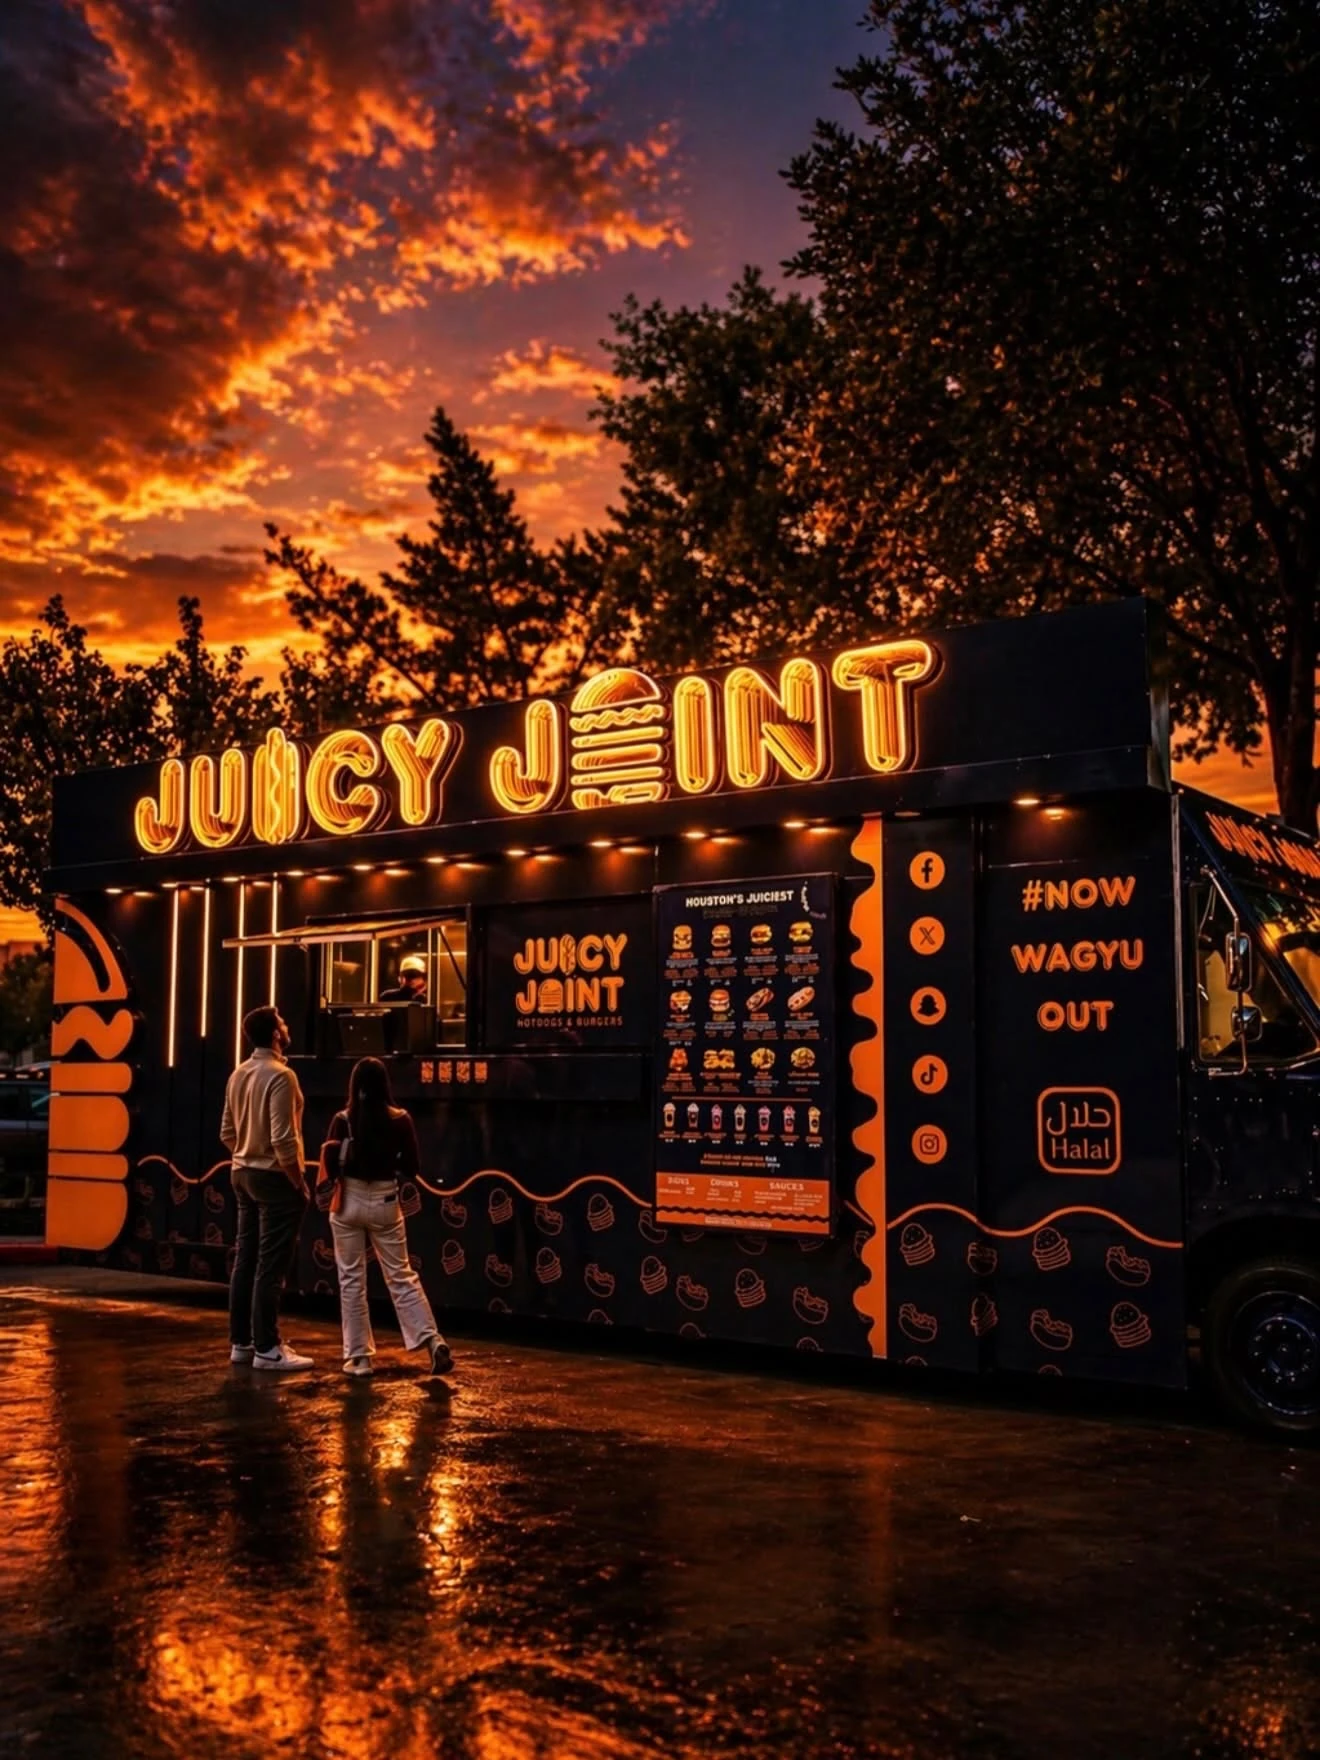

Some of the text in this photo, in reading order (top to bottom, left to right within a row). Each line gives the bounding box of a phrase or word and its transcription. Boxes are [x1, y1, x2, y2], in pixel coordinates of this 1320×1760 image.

[135, 718, 452, 853] JUICY
[685, 890, 795, 908] HOUSTON'S JUICIEST
[1022, 875, 1136, 912] #NOW
[513, 933, 628, 975] JUICY
[1010, 939, 1144, 974] WAGYU
[1037, 1000, 1114, 1032] OUT
[1046, 1101, 1111, 1135] حلال
[1051, 1137, 1110, 1160] Halal
